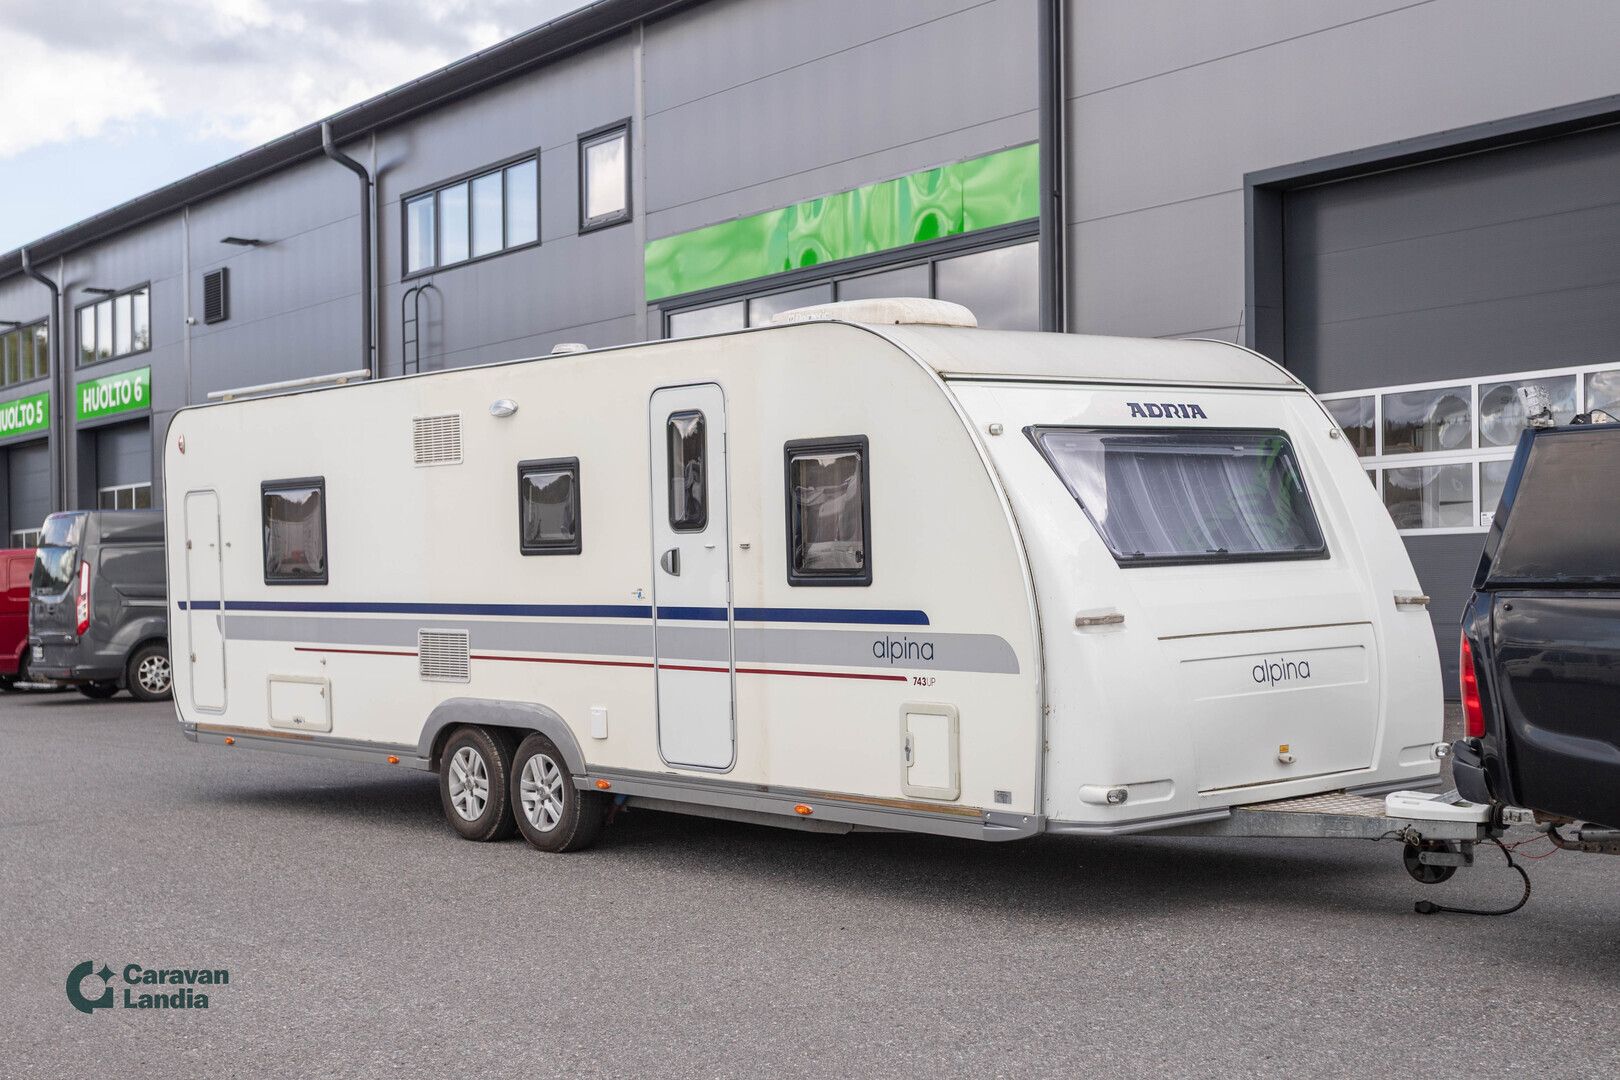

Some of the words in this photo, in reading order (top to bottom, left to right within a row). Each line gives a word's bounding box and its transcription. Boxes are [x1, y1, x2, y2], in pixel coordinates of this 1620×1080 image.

[83, 380, 131, 413] HUOLTO
[134, 376, 143, 402] 6
[0, 402, 35, 432] UOLTO
[36, 400, 43, 424] 5
[1126, 402, 1208, 420] ADRIA
[872, 635, 934, 664] alpina
[1252, 658, 1311, 687] alpina
